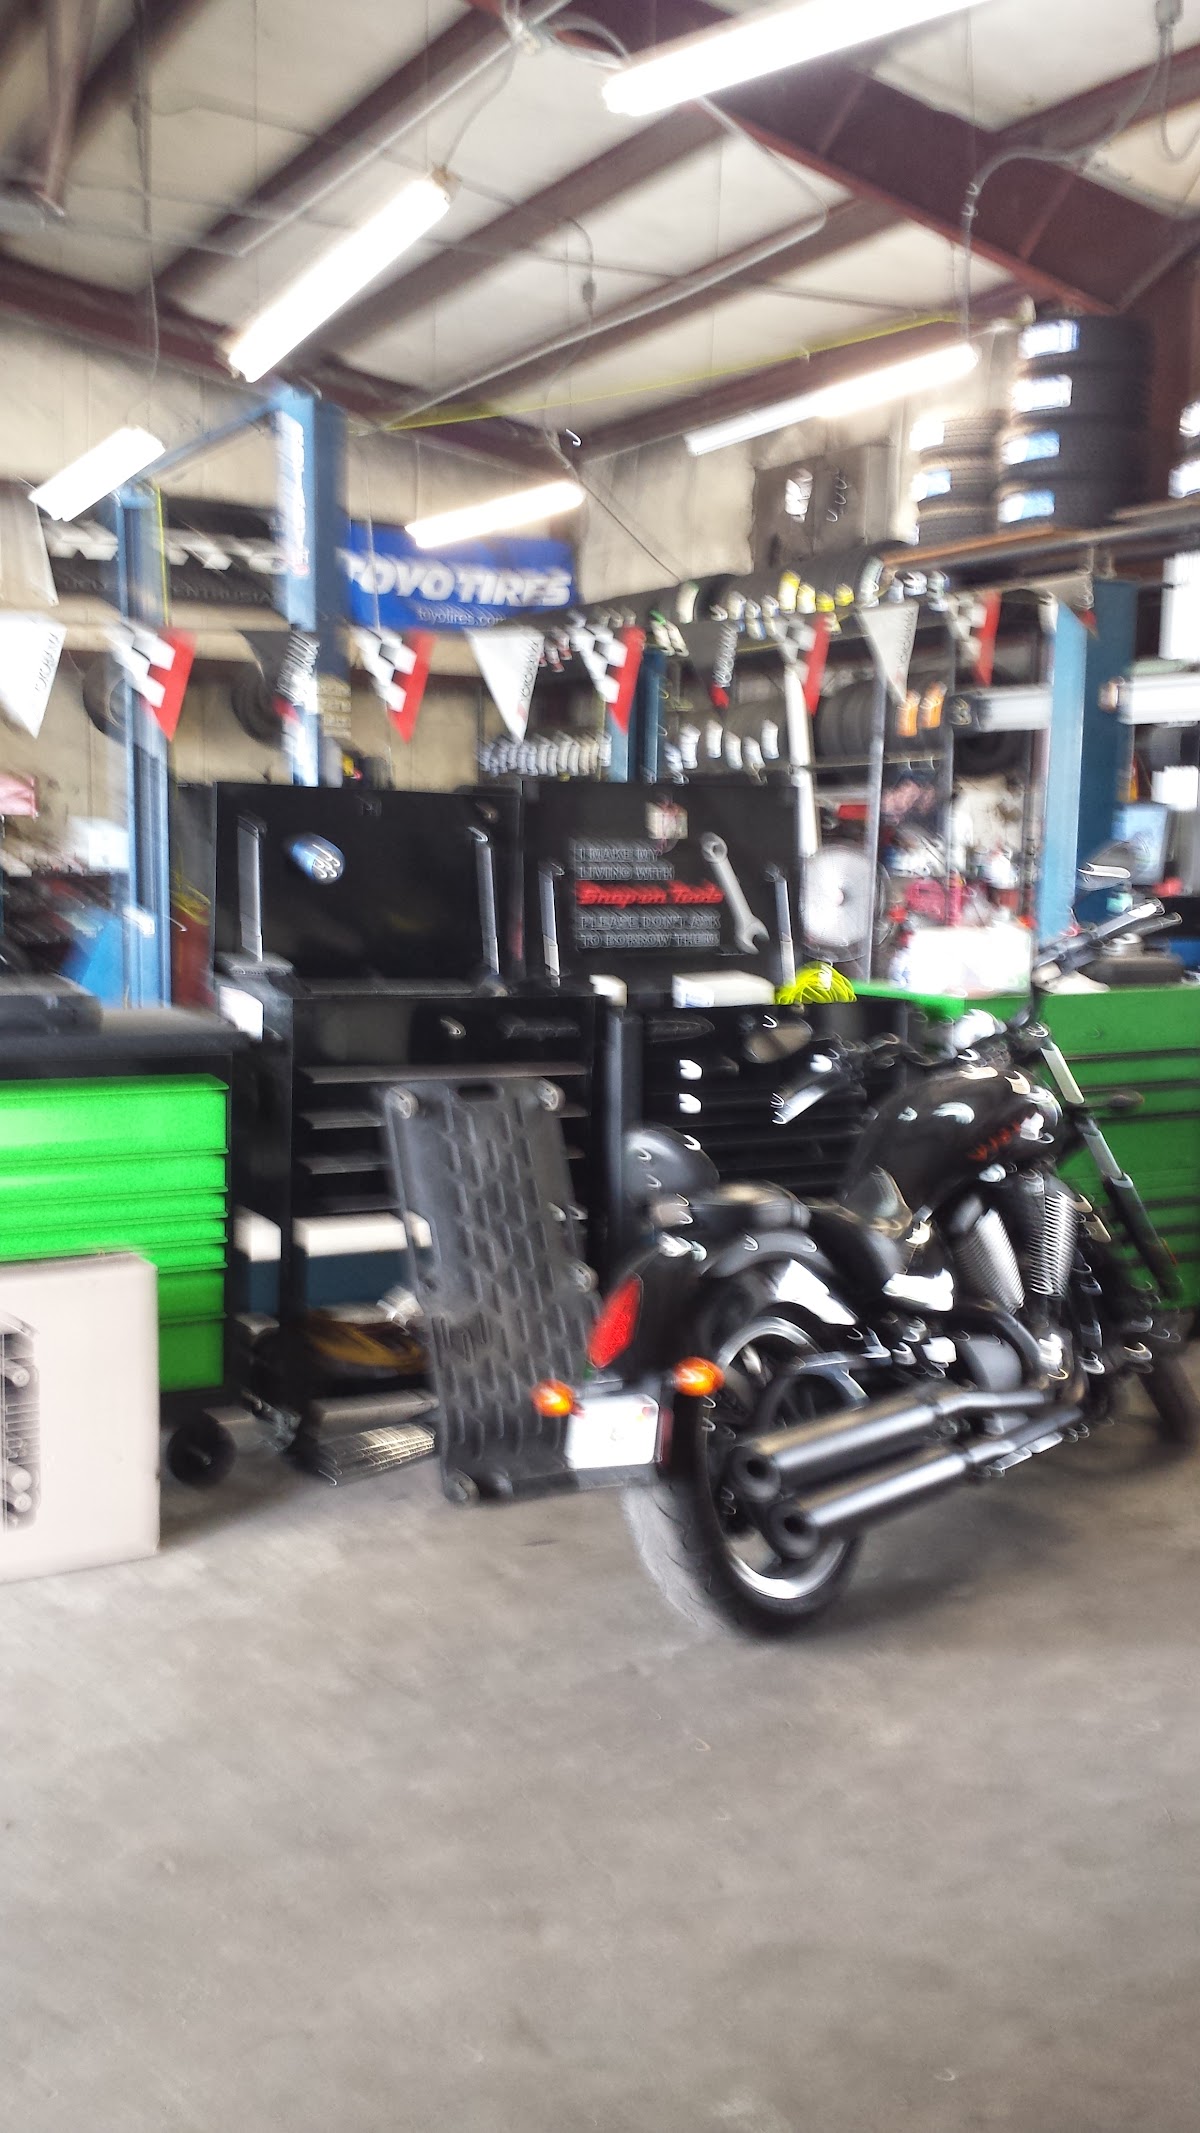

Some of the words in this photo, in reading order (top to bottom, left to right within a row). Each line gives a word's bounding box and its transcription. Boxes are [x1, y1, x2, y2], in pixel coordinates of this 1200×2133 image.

[456, 566, 572, 606] TIRES
[588, 847, 632, 862] MAKE
[579, 865, 633, 880] LIVING
[636, 865, 675, 880] WITH
[580, 915, 638, 930] PLEASE
[690, 915, 721, 930] ASK
[580, 933, 602, 948] TO
[606, 933, 671, 948] BORROW
